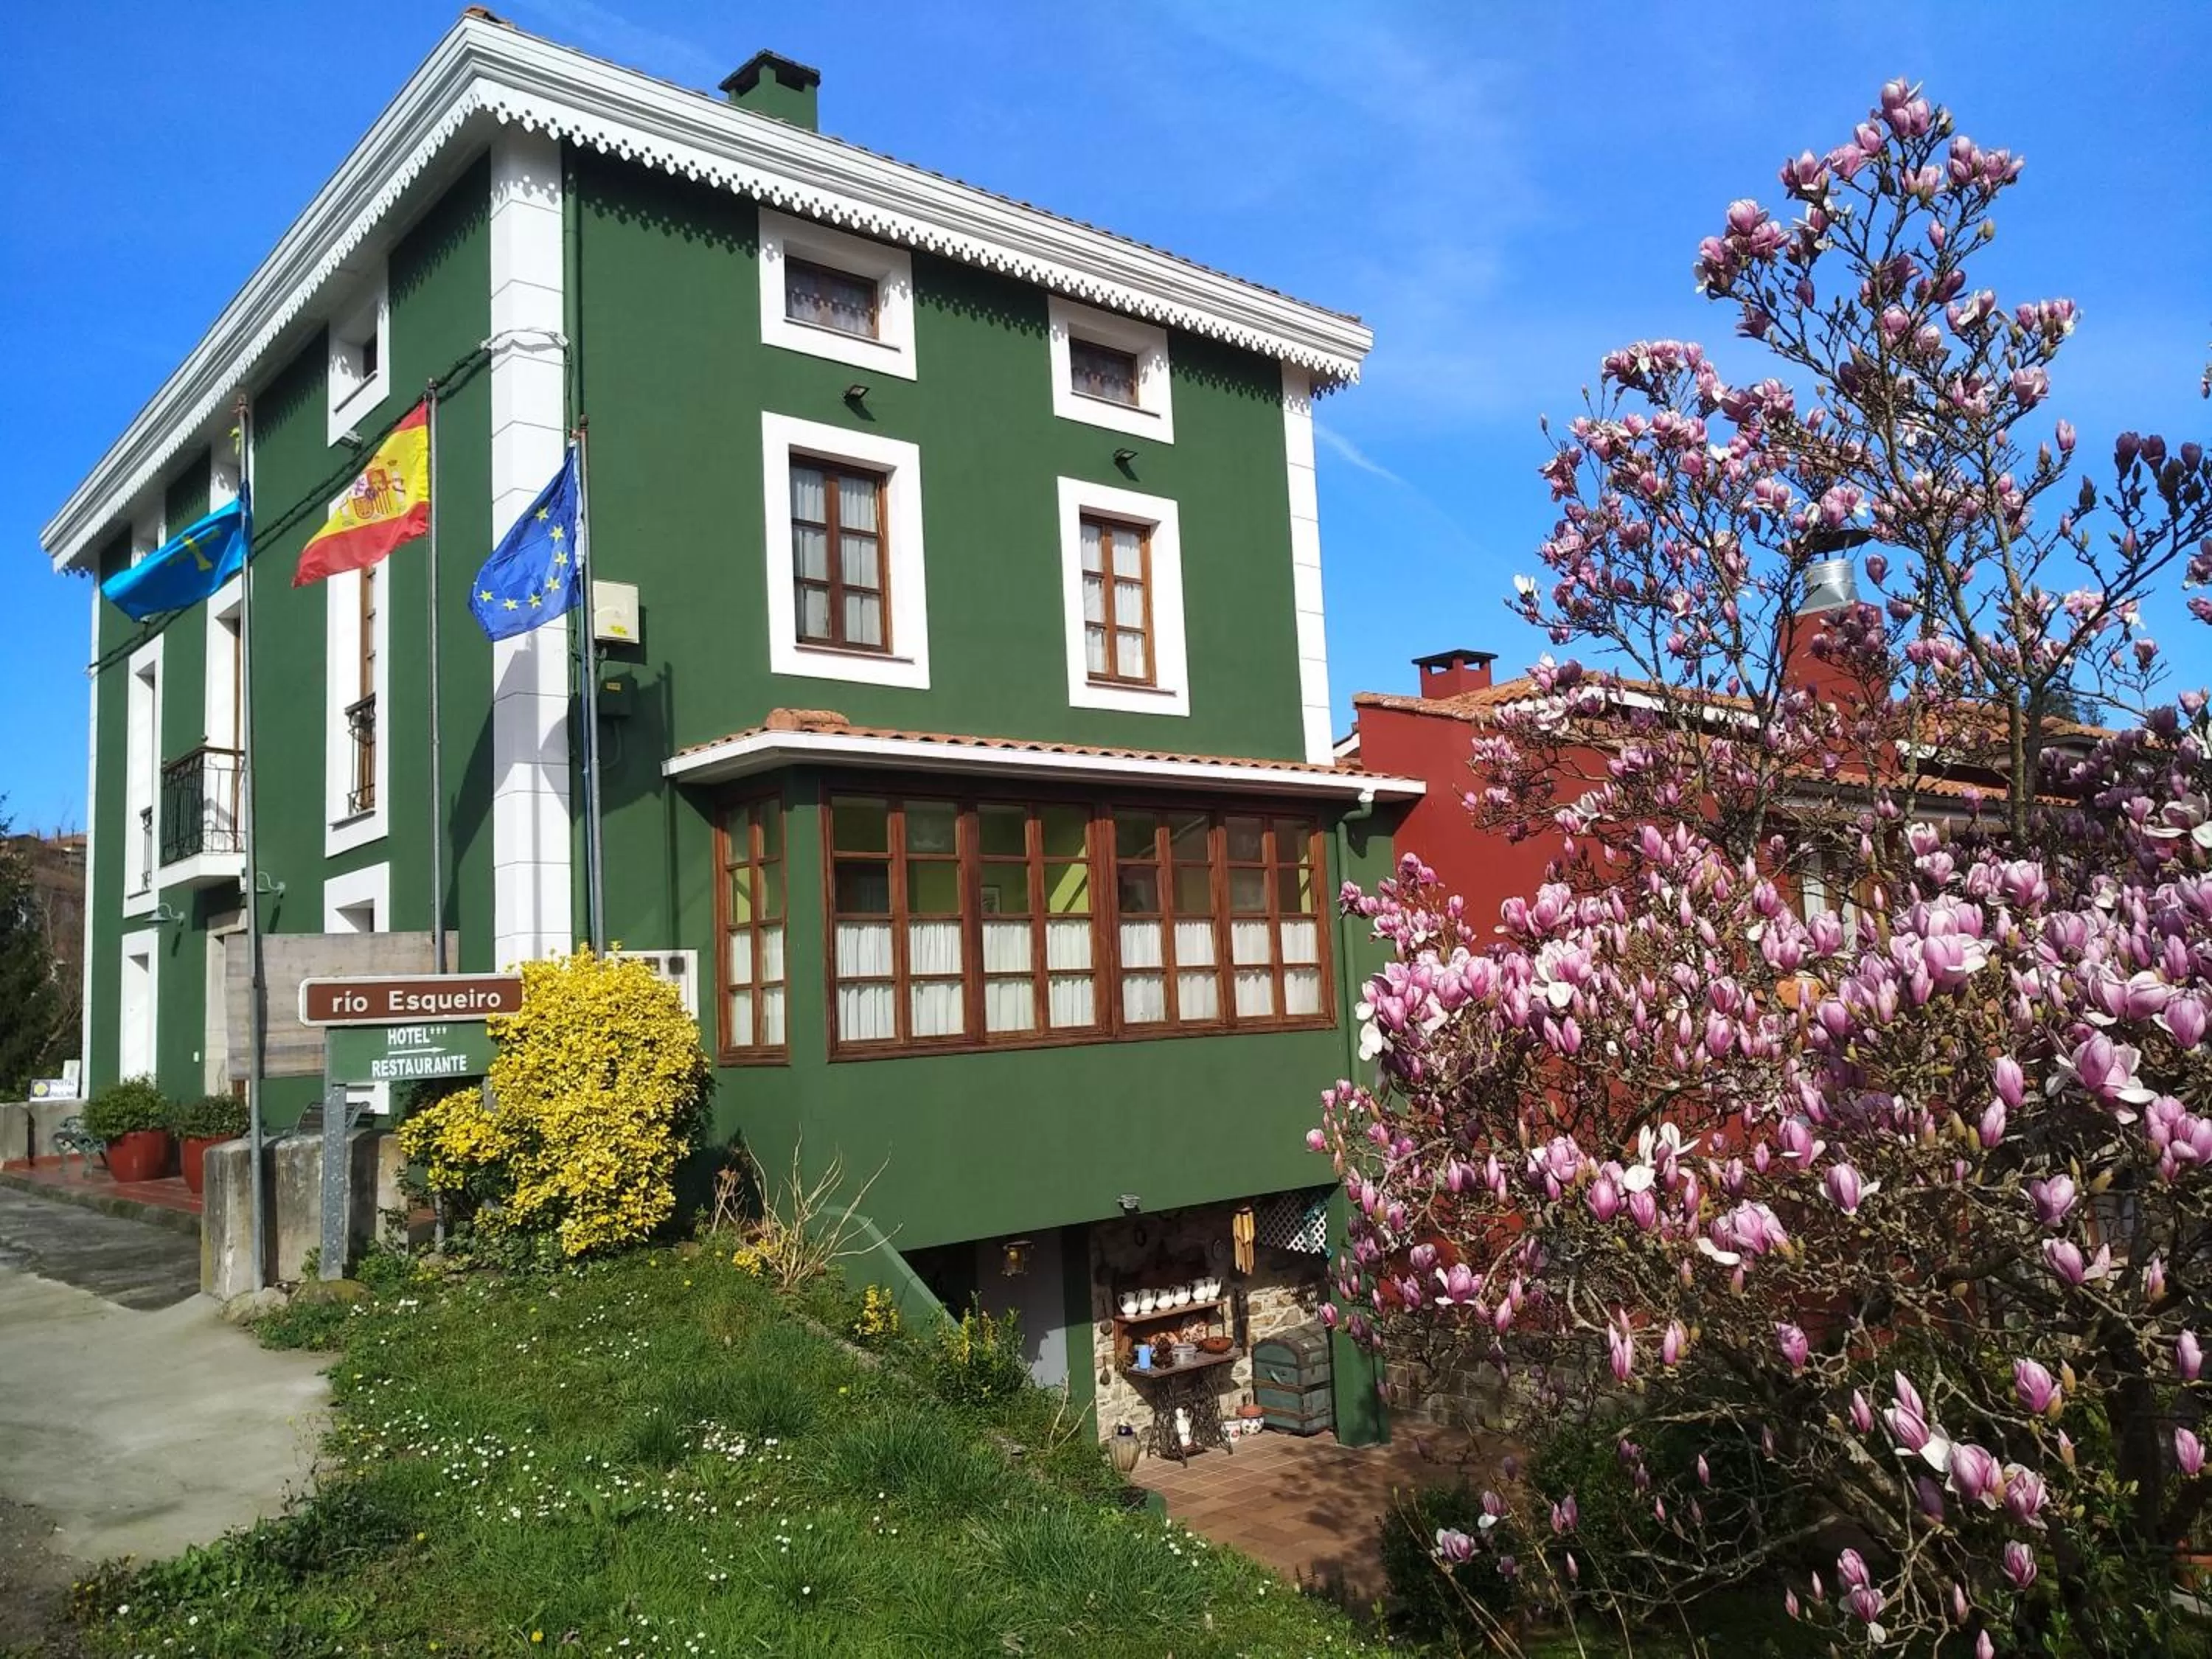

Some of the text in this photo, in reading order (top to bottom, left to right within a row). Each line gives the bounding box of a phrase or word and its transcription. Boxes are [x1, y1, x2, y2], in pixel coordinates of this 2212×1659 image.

[332, 988, 501, 1013] río Esqueiro
[371, 1055, 467, 1077] RESTAURANTE
